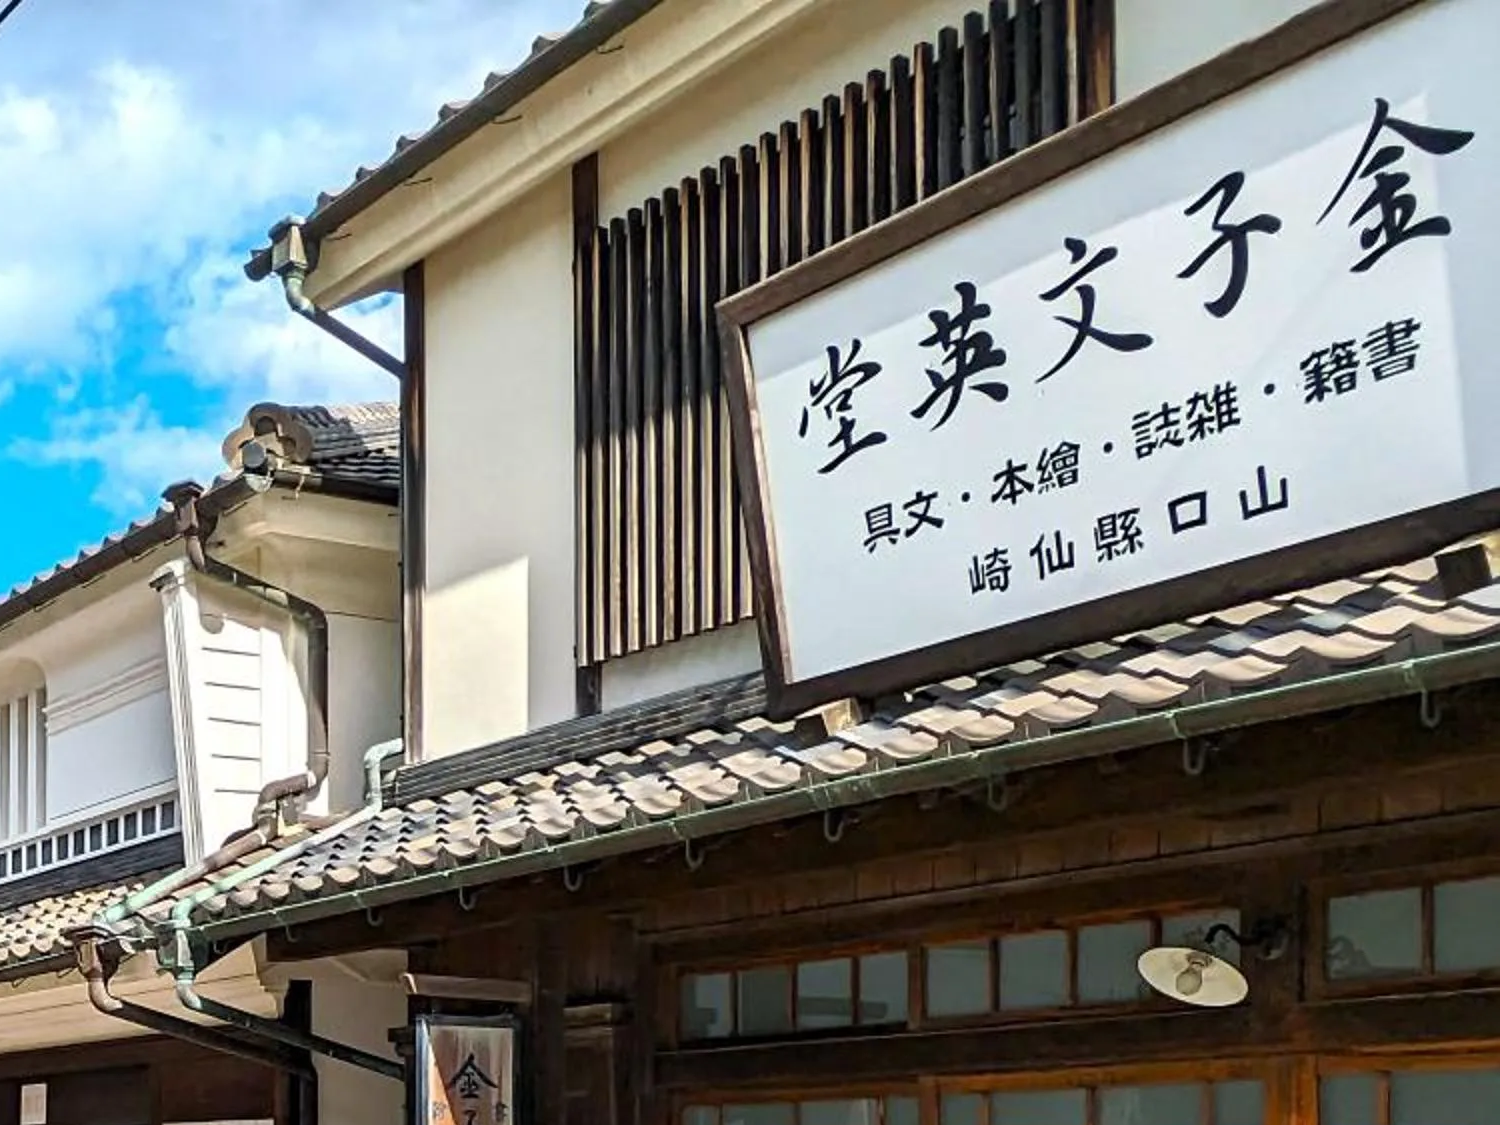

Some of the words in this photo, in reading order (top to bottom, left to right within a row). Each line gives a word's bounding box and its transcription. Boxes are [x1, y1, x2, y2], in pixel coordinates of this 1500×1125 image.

[799, 97, 1475, 475] 金子文英堂
[968, 464, 1289, 594] 山口縣仙崎
